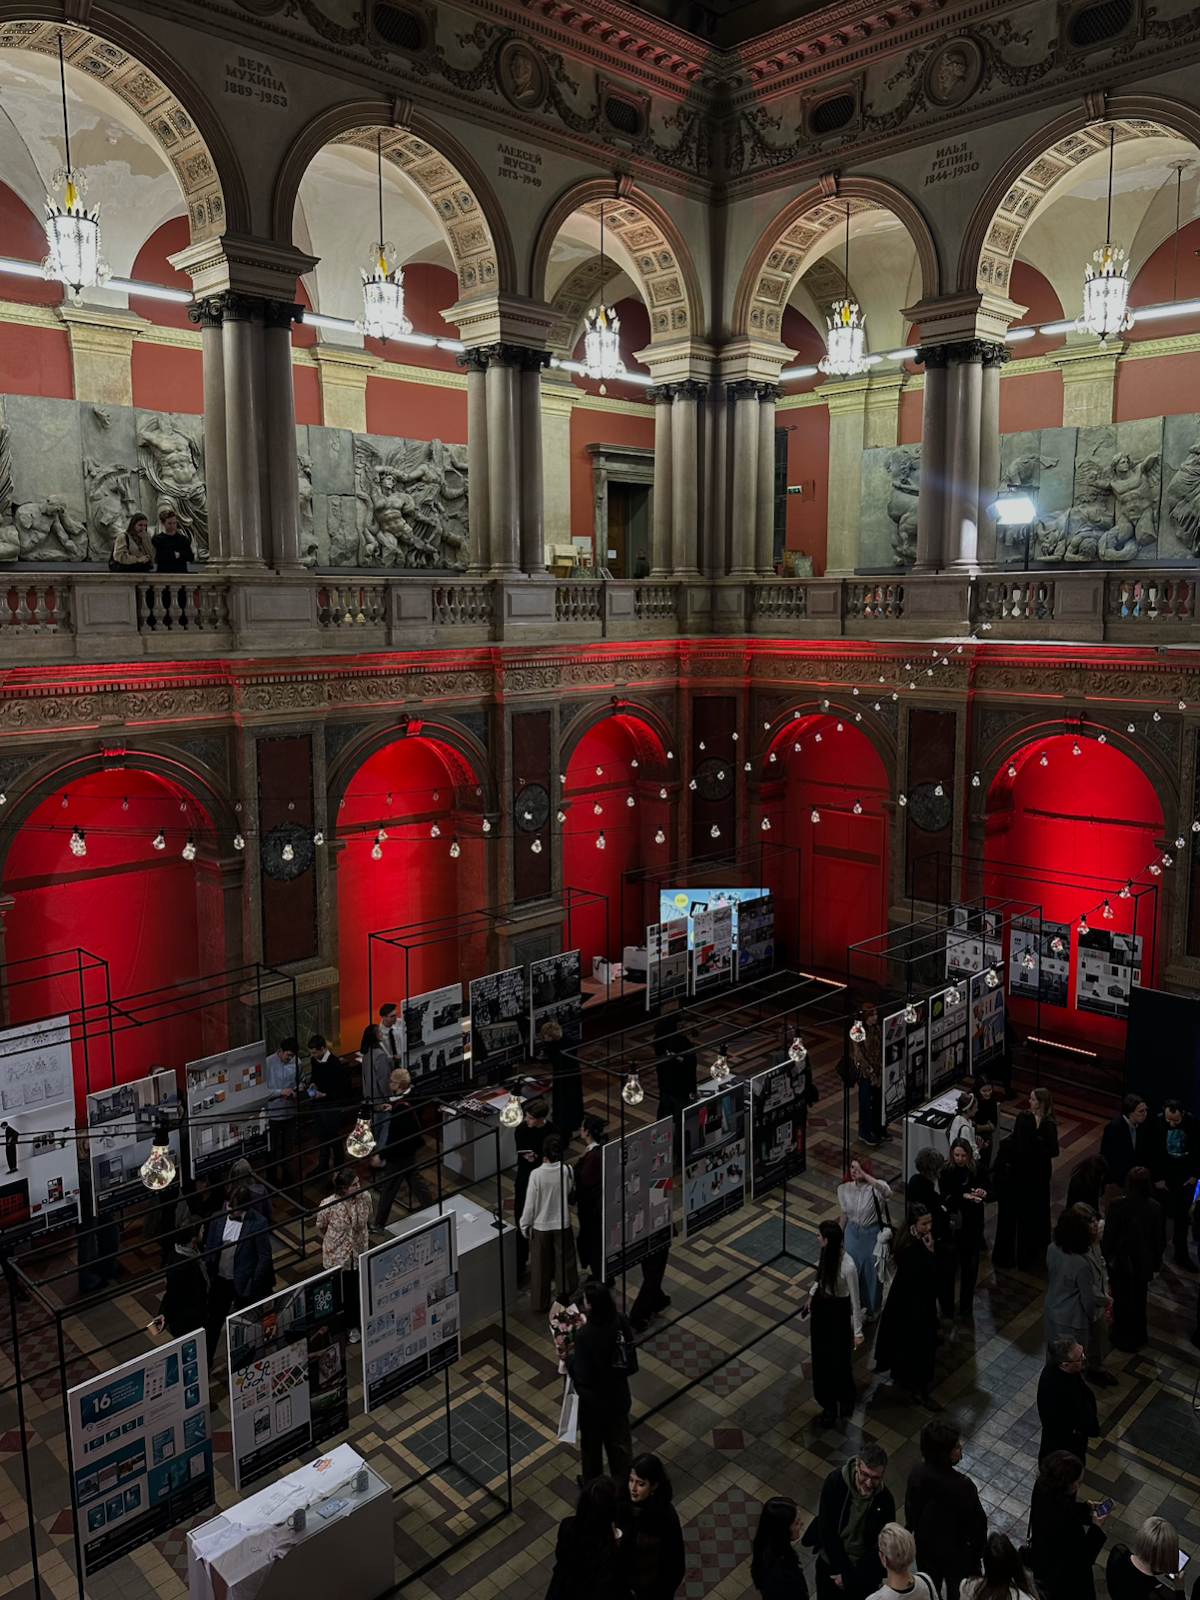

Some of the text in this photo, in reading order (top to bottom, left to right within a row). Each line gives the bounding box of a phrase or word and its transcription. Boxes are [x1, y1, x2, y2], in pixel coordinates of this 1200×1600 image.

[238, 56, 273, 77] ВЕРА
[226, 64, 287, 93] МУХИНА
[496, 143, 542, 166] АЛЕКСЕЙ
[931, 151, 973, 171] РЕПИН
[936, 142, 967, 159] ИЛЬЯ
[503, 156, 537, 174] ЩУСЕВ
[92, 1392, 112, 1414] 16
